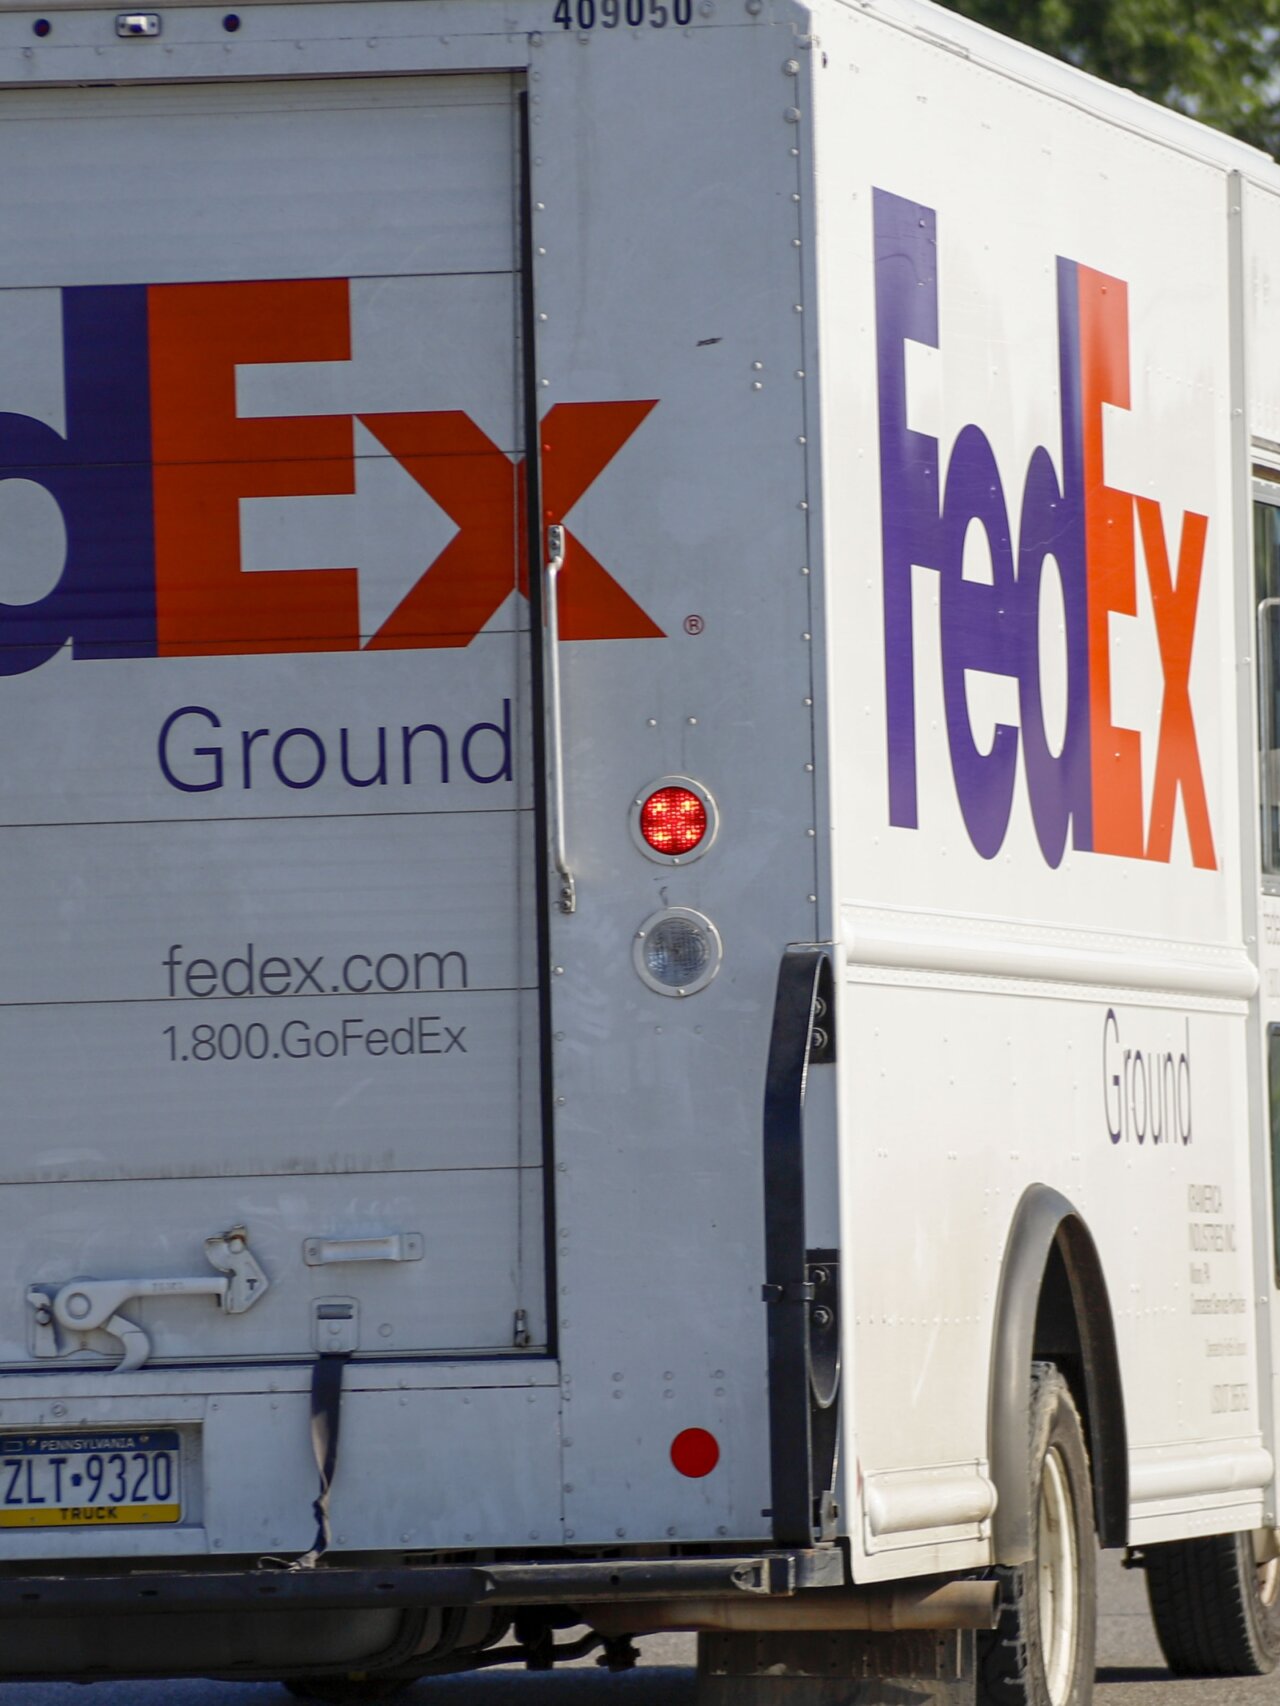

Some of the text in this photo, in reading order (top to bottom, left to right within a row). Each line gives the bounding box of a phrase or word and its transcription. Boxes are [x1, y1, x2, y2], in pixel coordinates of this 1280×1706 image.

[553, 0, 694, 30] 409050
[871, 186, 1218, 871] FedEx
[157, 698, 513, 793] Ground
[161, 943, 469, 997] fedex.com
[162, 1016, 468, 1061] 1.800.GoFedEx
[1103, 1007, 1192, 1147] Ground
[40, 1437, 136, 1450] PENNSYLVANIA
[61, 1506, 118, 1520] TRUCK
